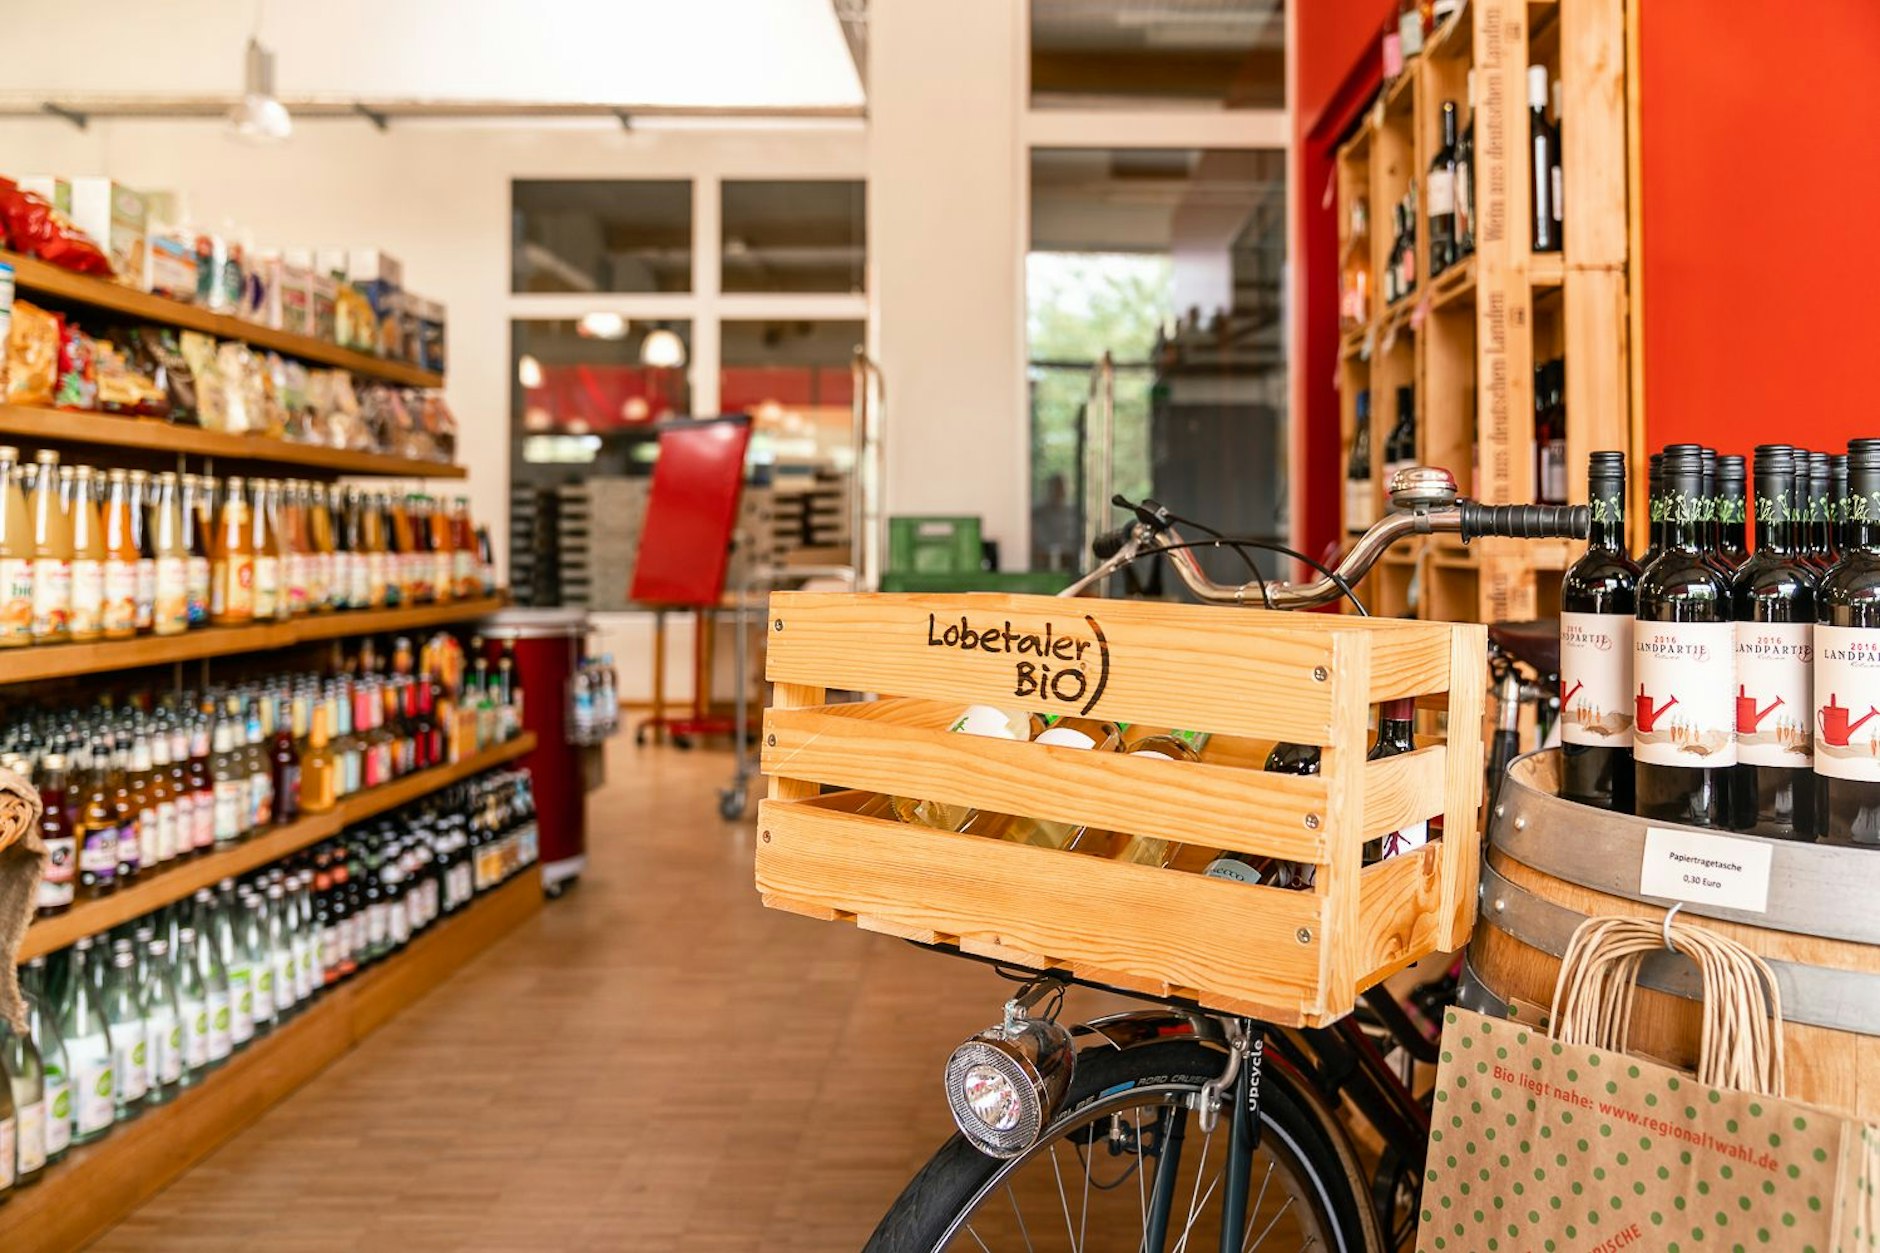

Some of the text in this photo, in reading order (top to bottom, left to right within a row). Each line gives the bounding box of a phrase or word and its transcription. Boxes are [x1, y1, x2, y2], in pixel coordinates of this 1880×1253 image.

[1483, 76, 1504, 159] deutschen
[1484, 291, 1506, 354] Landen
[1487, 360, 1509, 446] deutschen
[928, 613, 1091, 660] Lobetaler
[1654, 635, 1677, 644] 2016
[1756, 636, 1782, 645] 2016
[1636, 641, 1708, 657] LANDPARTIE
[1824, 649, 1880, 662] LANDPA
[1850, 642, 1877, 651] 2016
[1669, 851, 1743, 872] Papiertragetasche
[1682, 874, 1722, 889] 0,30 Euro
[1493, 1065, 1780, 1172] Bio liegt nahe: www.regional1wahl.de
